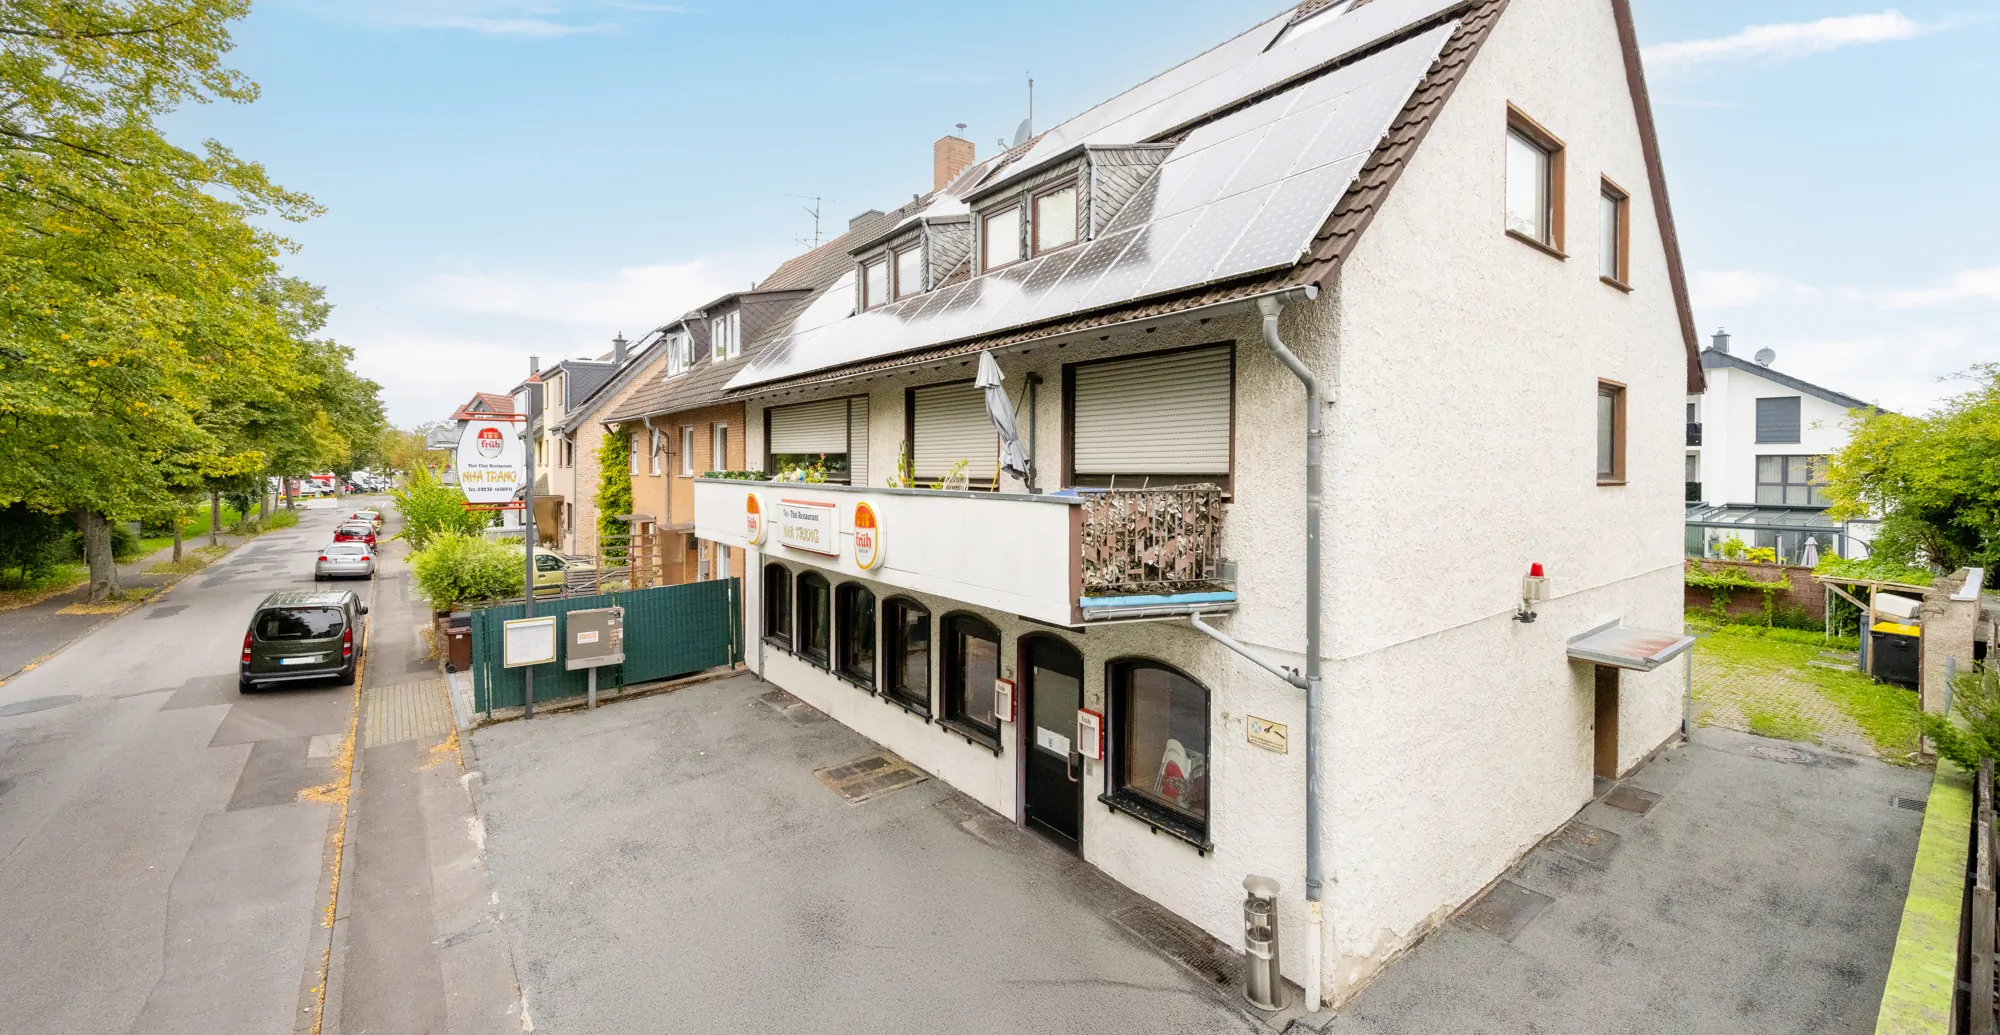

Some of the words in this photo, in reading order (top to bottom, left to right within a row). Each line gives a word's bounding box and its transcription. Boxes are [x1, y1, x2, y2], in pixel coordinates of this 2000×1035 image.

[481, 440, 500, 448] früh
[462, 470, 483, 482] NHA
[485, 470, 517, 482] TRANG
[798, 511, 819, 521] Restaurant
[855, 531, 872, 549] früh
